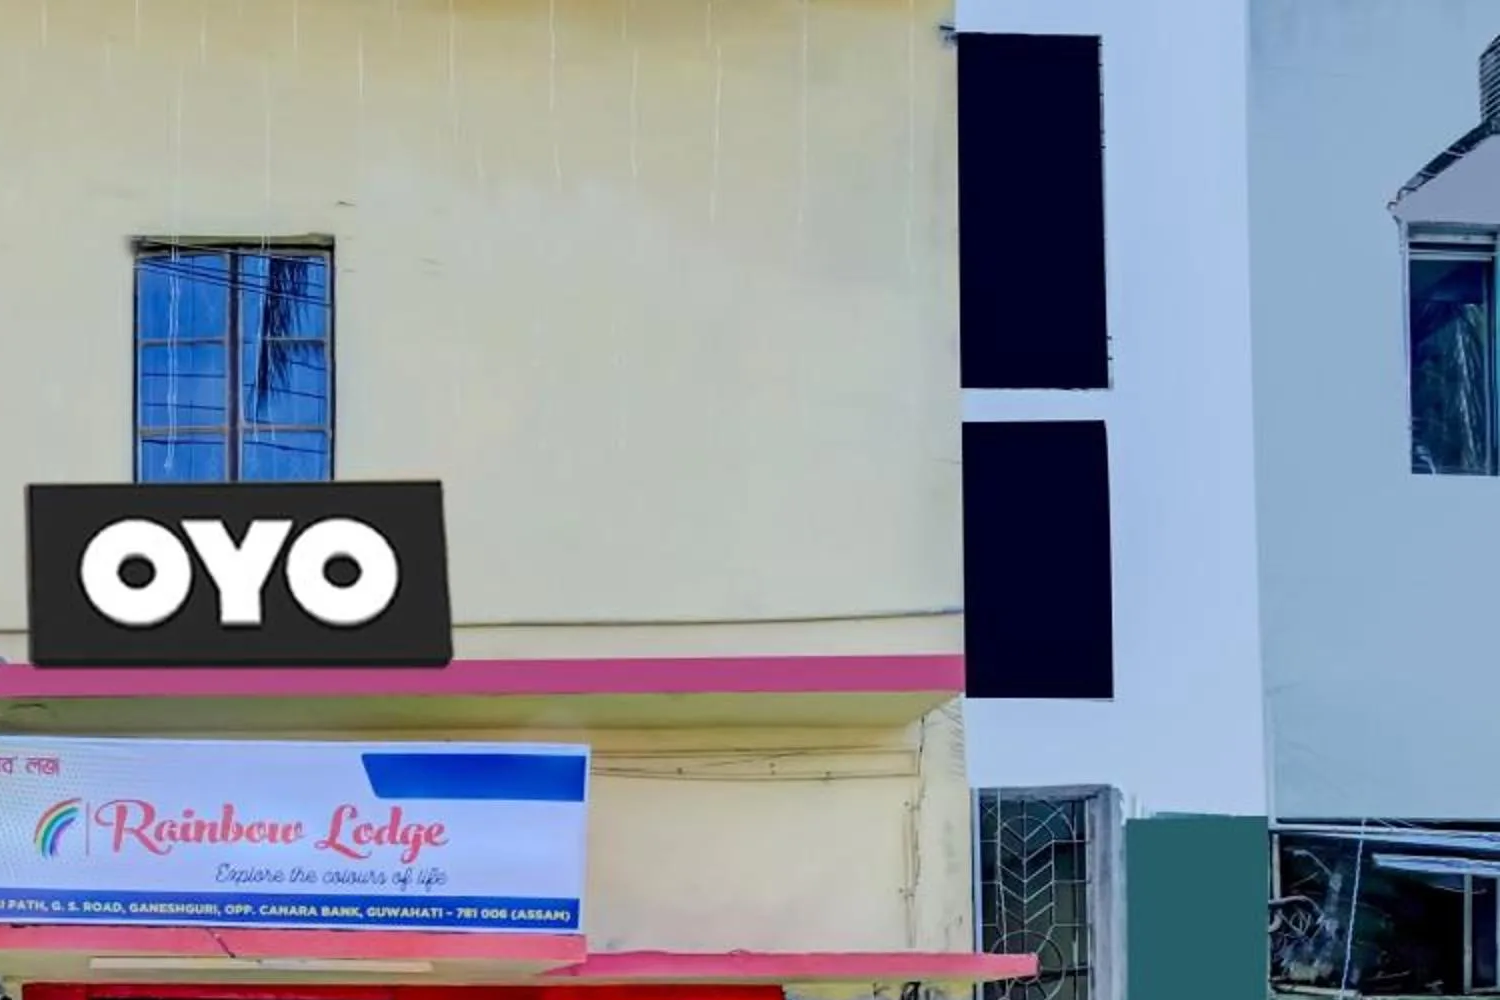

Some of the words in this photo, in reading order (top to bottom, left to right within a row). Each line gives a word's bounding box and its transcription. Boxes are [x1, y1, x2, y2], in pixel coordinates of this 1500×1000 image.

[80, 517, 400, 626] OYO
[94, 799, 304, 855] Rainbow
[314, 803, 449, 864] Lodge
[215, 862, 285, 887] Explore
[289, 863, 317, 884] the
[322, 867, 387, 886] colours
[392, 866, 412, 892] of
[416, 866, 447, 892] life
[7, 898, 48, 912] PATH,
[51, 900, 65, 912] G.
[67, 901, 80, 912] S.
[83, 901, 127, 914] ROAD,
[128, 902, 222, 917] GANESHGURI,
[224, 903, 257, 916] OPP.
[259, 904, 317, 917] CANARA
[321, 905, 364, 919] BANK,
[367, 905, 443, 919] GUWAHATI
[456, 907, 478, 920] 781
[481, 907, 507, 920] 006
[510, 908, 571, 923] (ASSAM)
